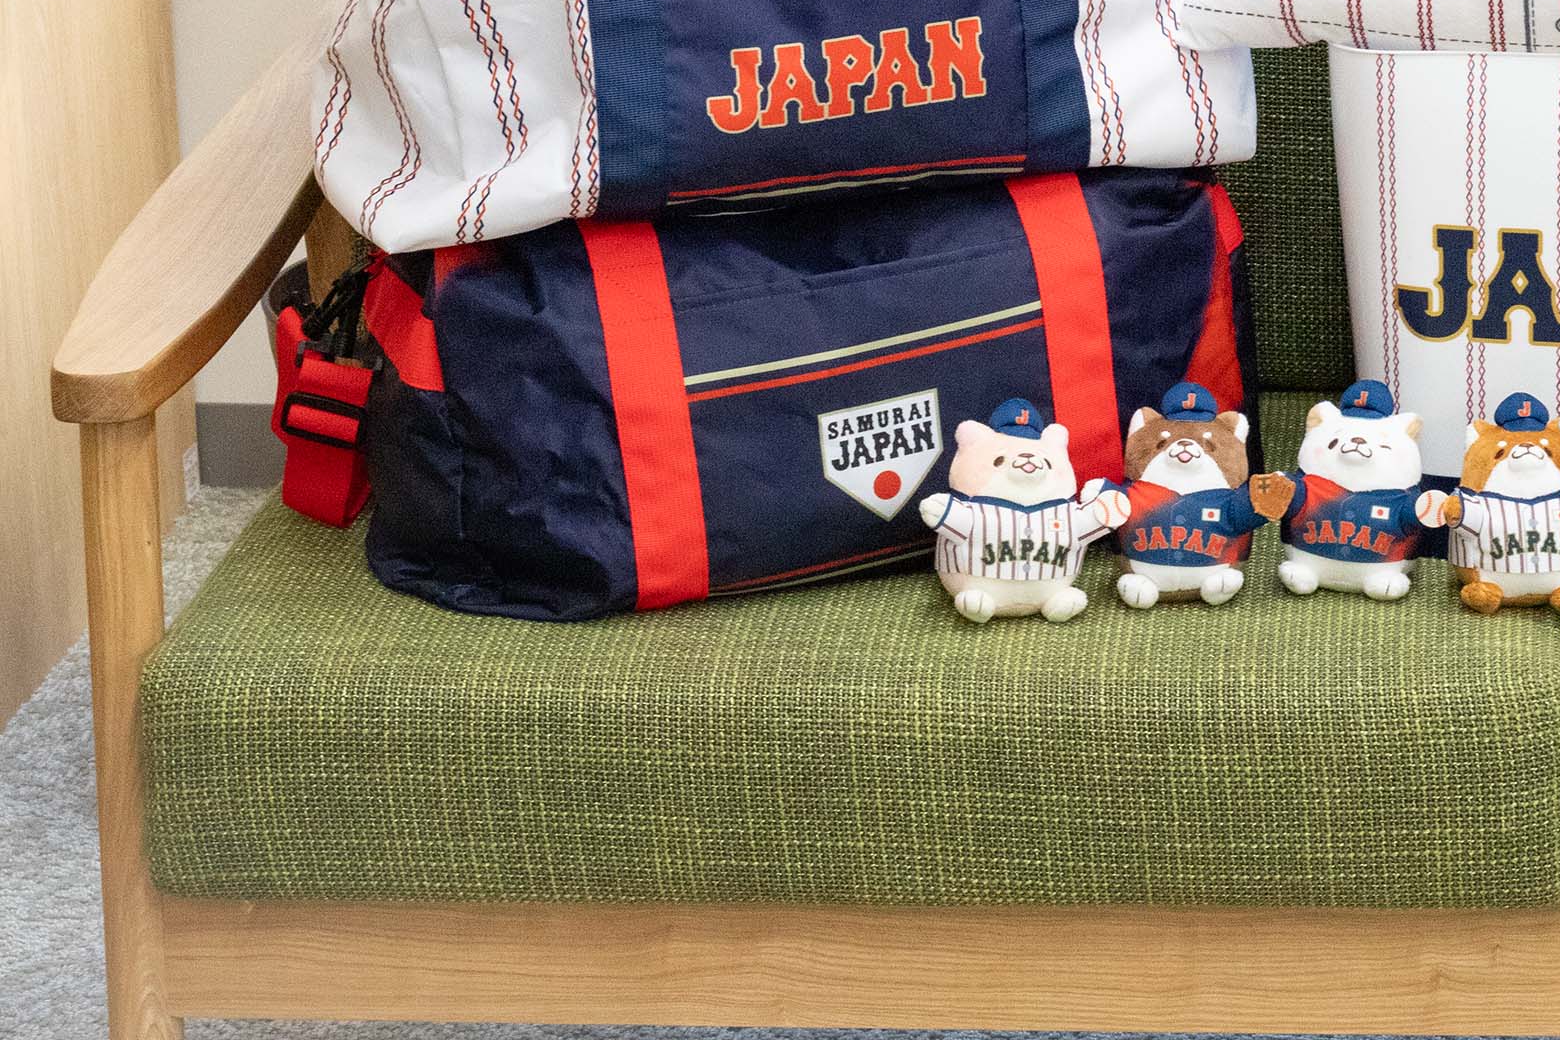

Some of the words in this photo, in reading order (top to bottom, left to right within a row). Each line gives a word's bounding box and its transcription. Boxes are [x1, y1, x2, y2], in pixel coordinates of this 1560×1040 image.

[706, 16, 987, 134] JAPAN
[1182, 392, 1196, 409] J
[1354, 390, 1368, 407] J
[1517, 400, 1531, 417] J
[827, 400, 932, 440] SAMURAI
[1015, 409, 1029, 426] J
[831, 420, 936, 472] JAPAN
[981, 538, 1070, 568] JAPAN
[1133, 526, 1228, 558] JAPAN
[1303, 520, 1396, 556] JAPAN
